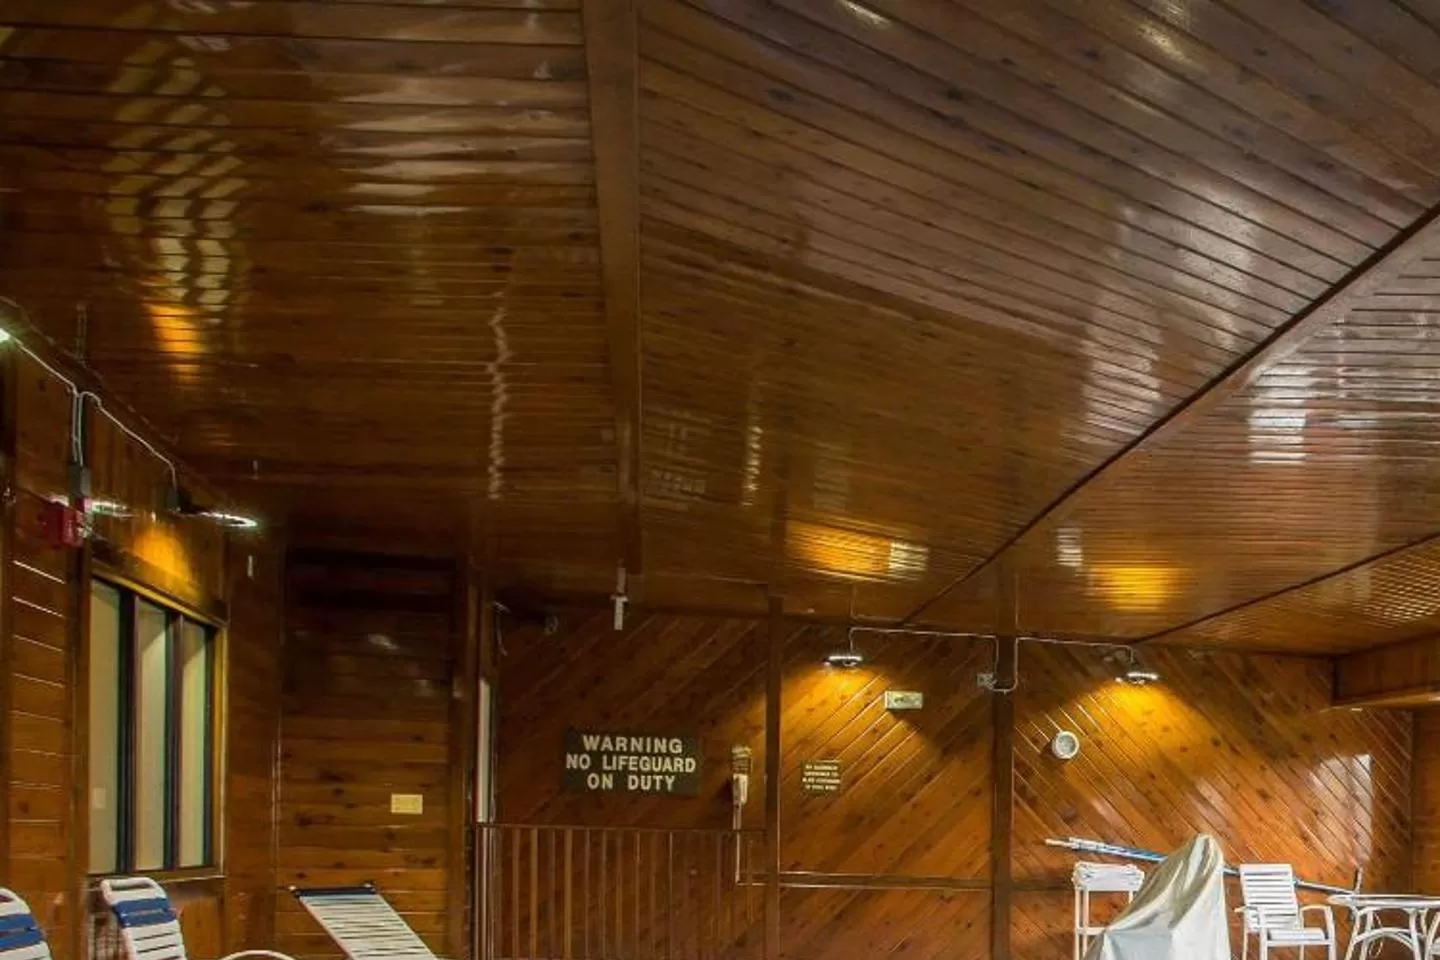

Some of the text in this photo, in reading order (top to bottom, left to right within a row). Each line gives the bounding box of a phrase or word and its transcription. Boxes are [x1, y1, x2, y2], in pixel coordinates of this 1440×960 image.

[583, 735, 683, 754] WARNING
[566, 752, 696, 773] NO LIFEGUARD
[587, 773, 675, 791] ON DUTY
